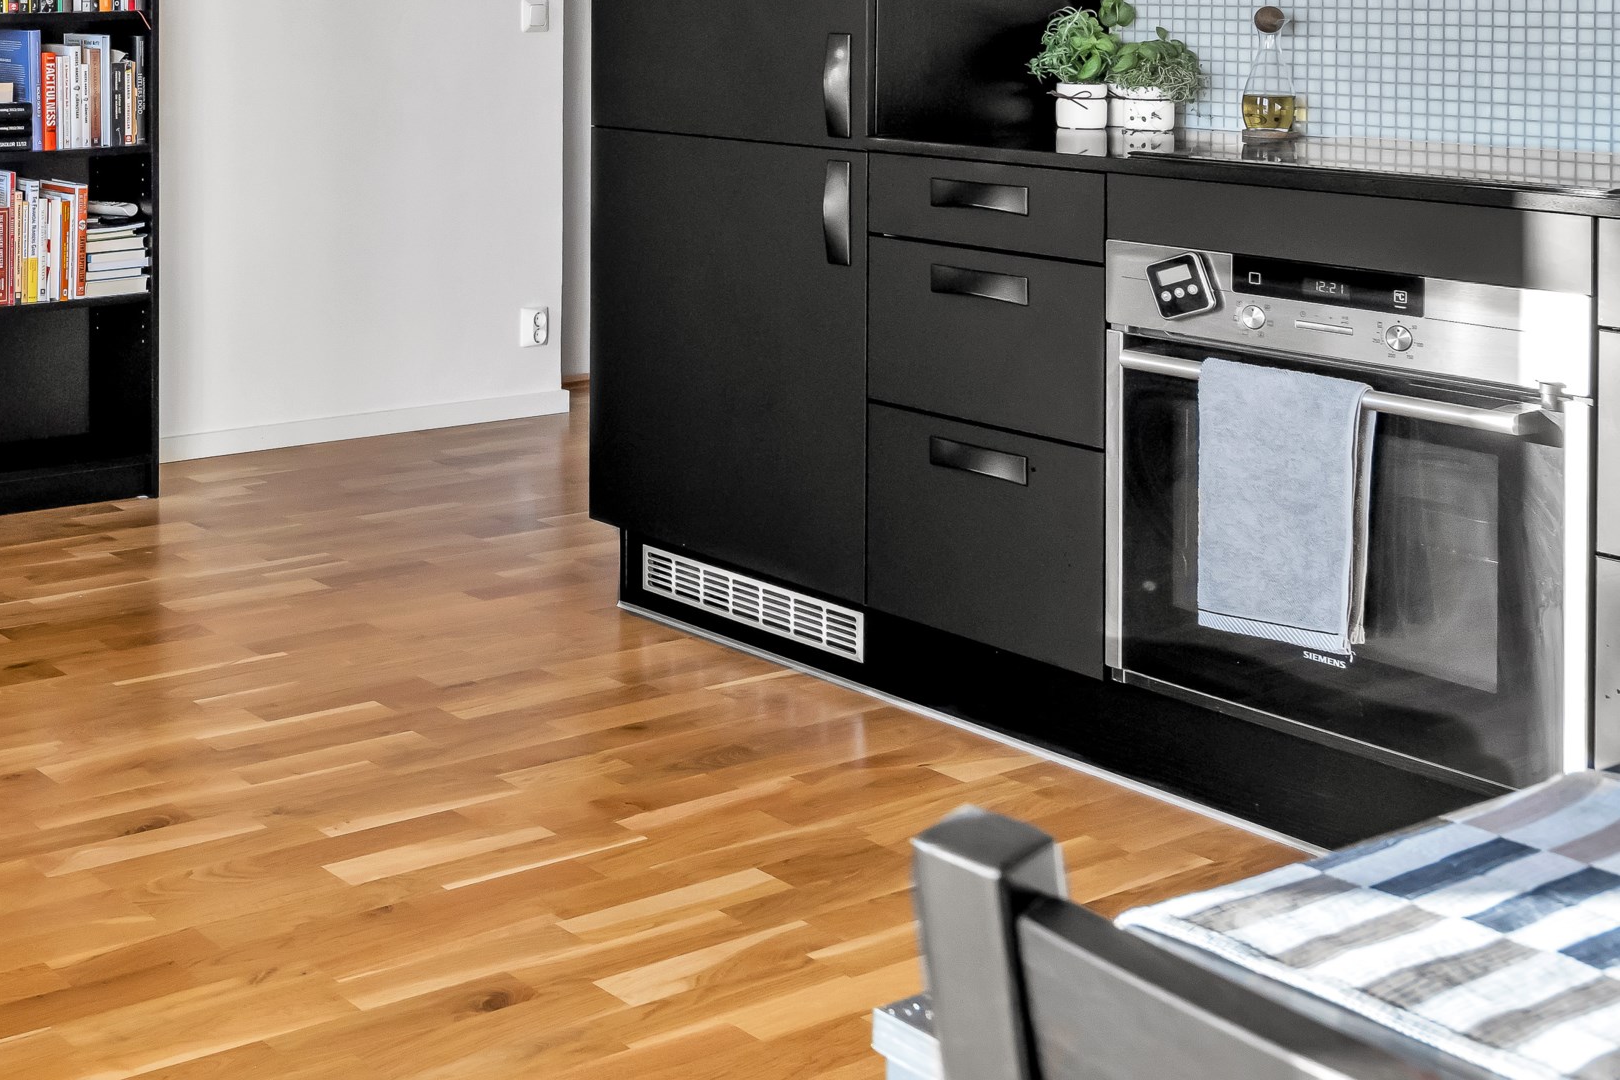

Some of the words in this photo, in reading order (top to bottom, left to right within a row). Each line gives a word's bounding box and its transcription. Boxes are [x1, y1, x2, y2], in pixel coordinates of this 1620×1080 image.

[46, 63, 56, 126] FACTFULNESS
[1316, 281, 1344, 294] 12:21
[1303, 650, 1346, 669] SIEMENS
